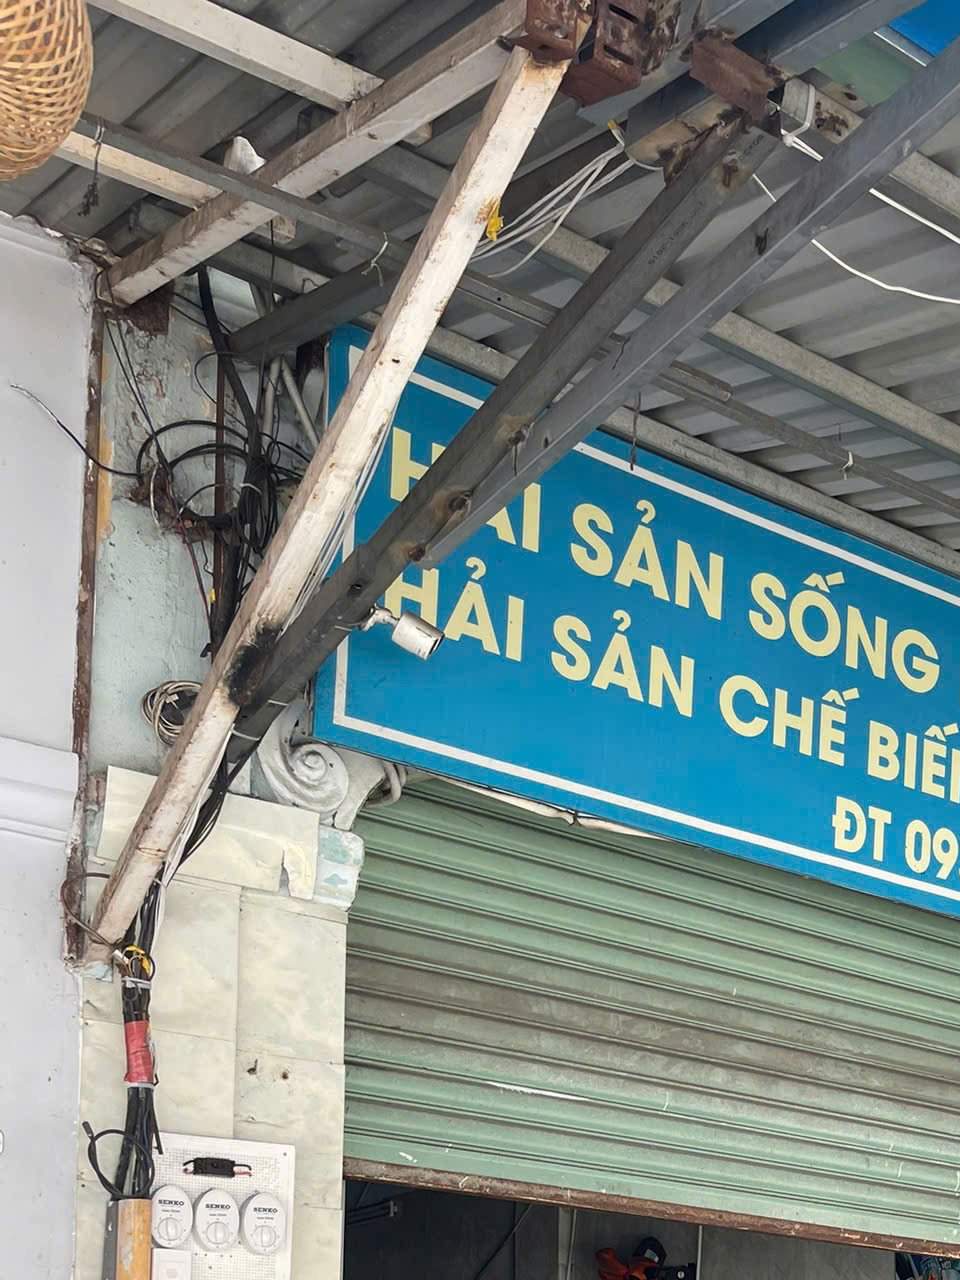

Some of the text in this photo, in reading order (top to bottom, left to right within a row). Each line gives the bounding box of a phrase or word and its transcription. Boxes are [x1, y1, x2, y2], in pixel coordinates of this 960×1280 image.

[384, 557, 525, 662] HẢI
[551, 610, 694, 718] SẢN
[719, 687, 860, 766] CHẾ
[391, 427, 541, 553] HI
[570, 499, 724, 620] SẢN
[749, 571, 941, 694] SỐNG
[832, 796, 893, 862] ĐT
